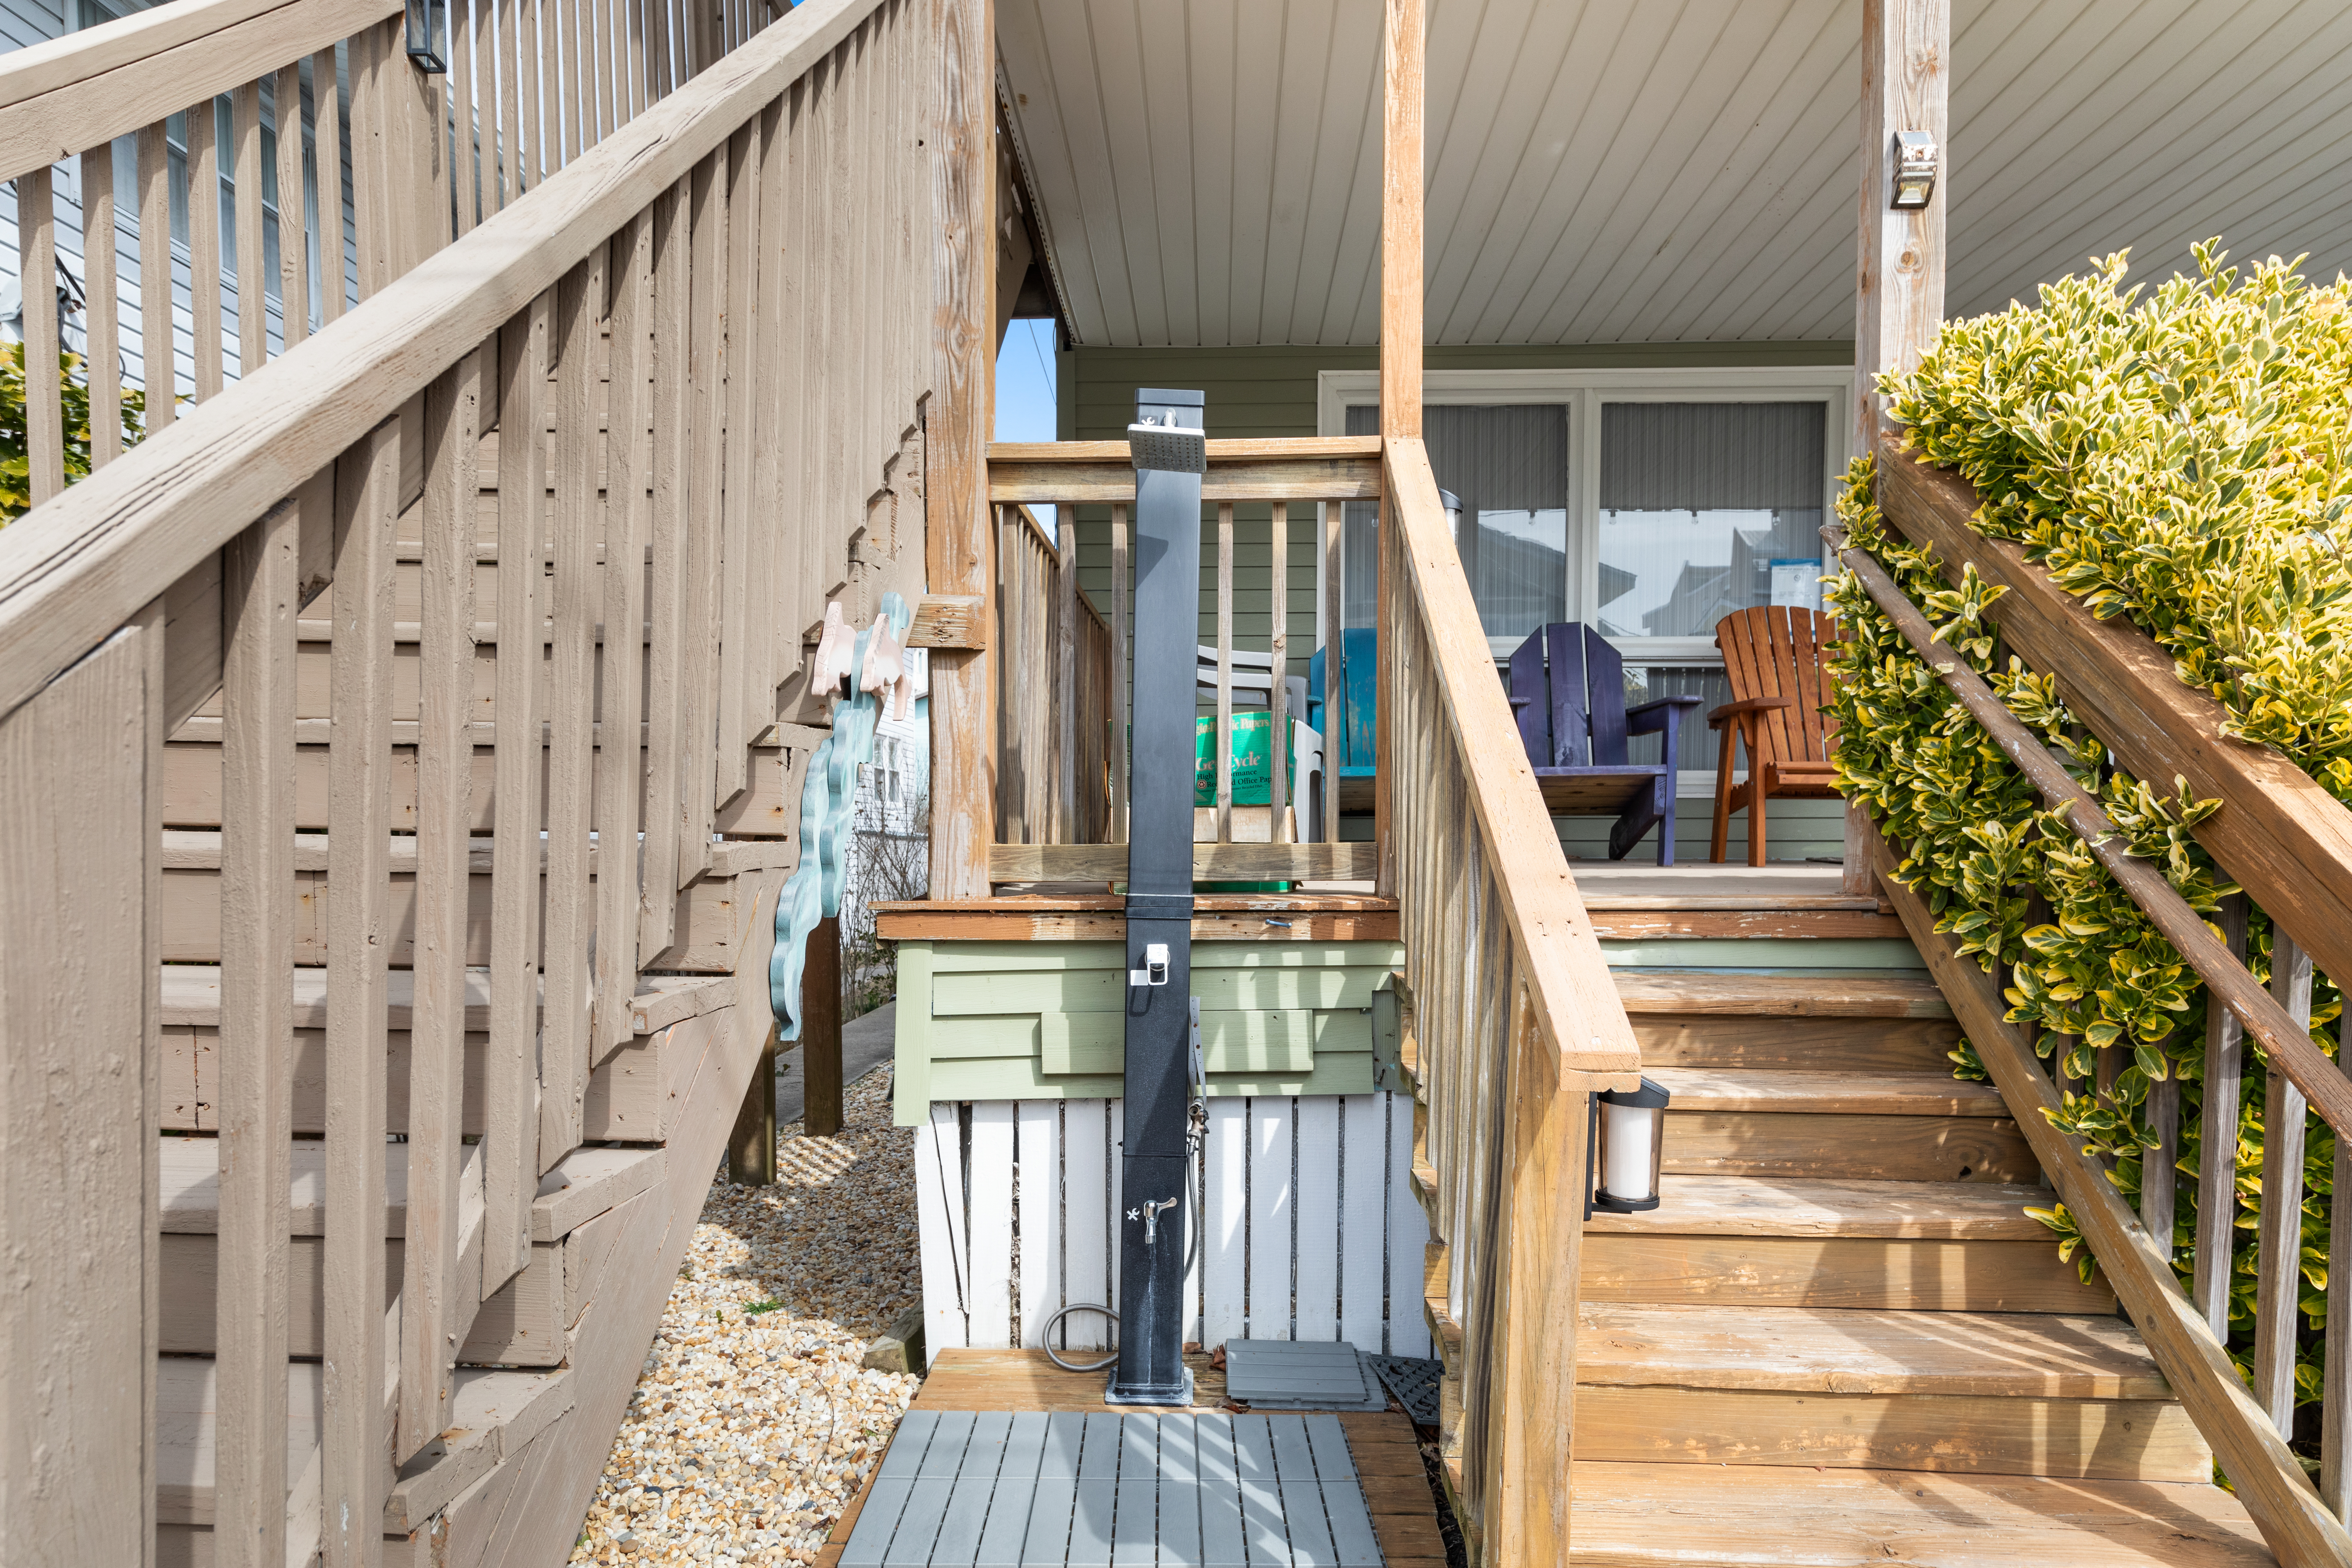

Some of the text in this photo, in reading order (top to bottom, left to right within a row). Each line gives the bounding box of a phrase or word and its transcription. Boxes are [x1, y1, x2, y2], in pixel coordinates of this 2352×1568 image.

[1240, 718, 1269, 732] Papers
[1195, 751, 1261, 771] Geycle
[1197, 772, 1213, 781] High
